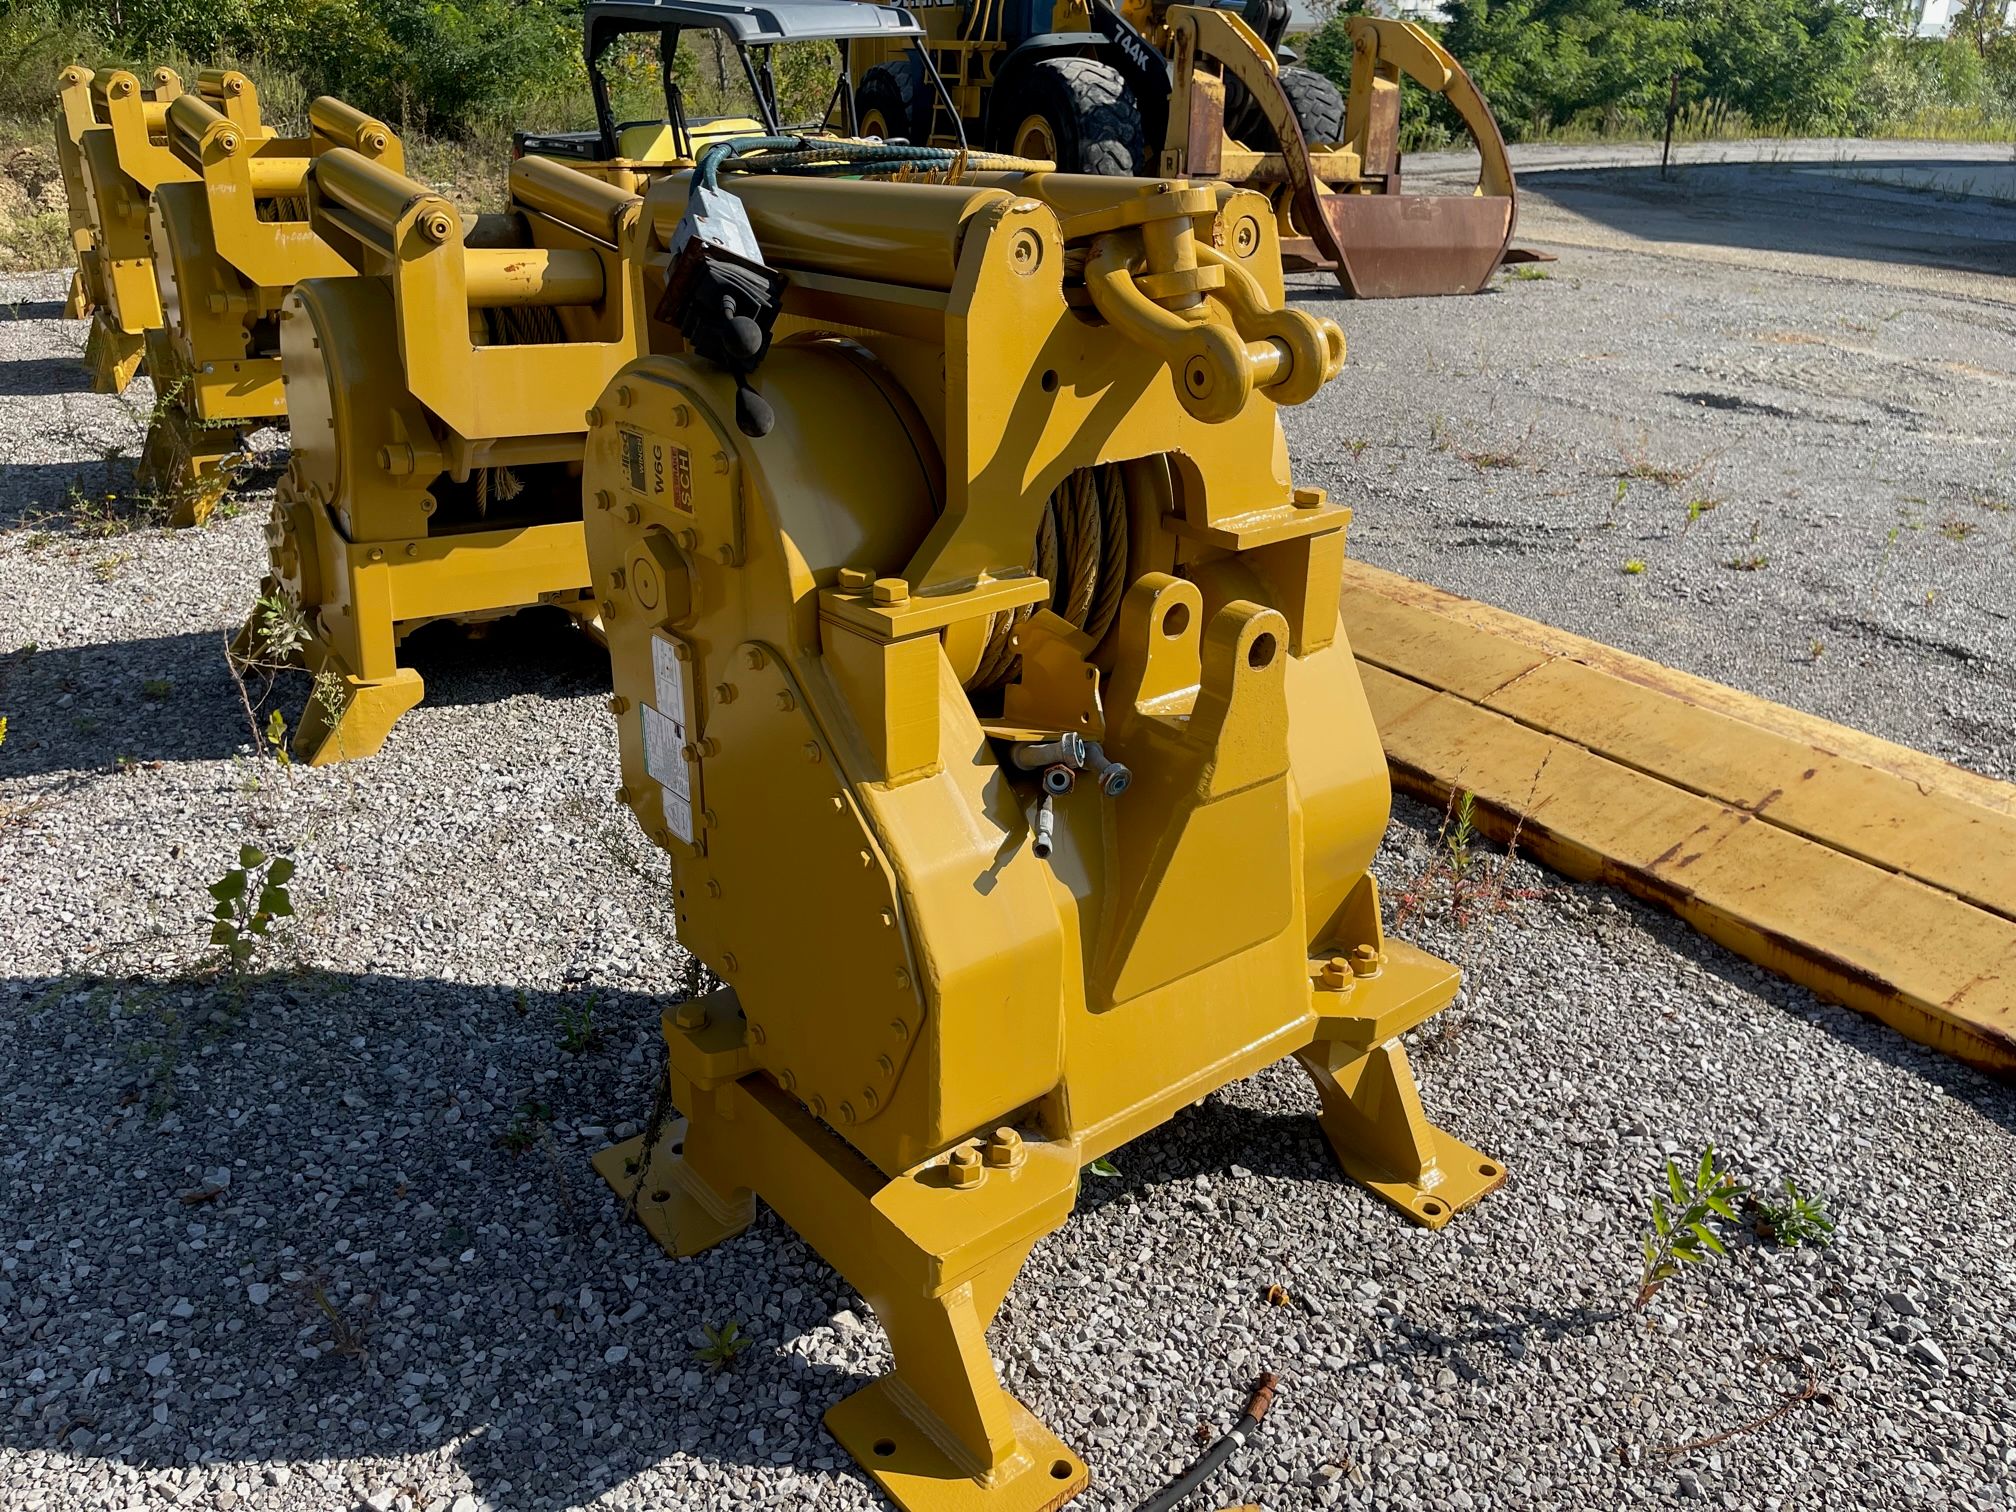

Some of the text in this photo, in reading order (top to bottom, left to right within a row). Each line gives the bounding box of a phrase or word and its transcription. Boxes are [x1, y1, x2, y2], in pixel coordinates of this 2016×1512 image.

[1114, 23, 1149, 71] 744K
[637, 437, 645, 474] WINCH
[653, 444, 664, 494] W6G
[679, 452, 692, 505] SCH
